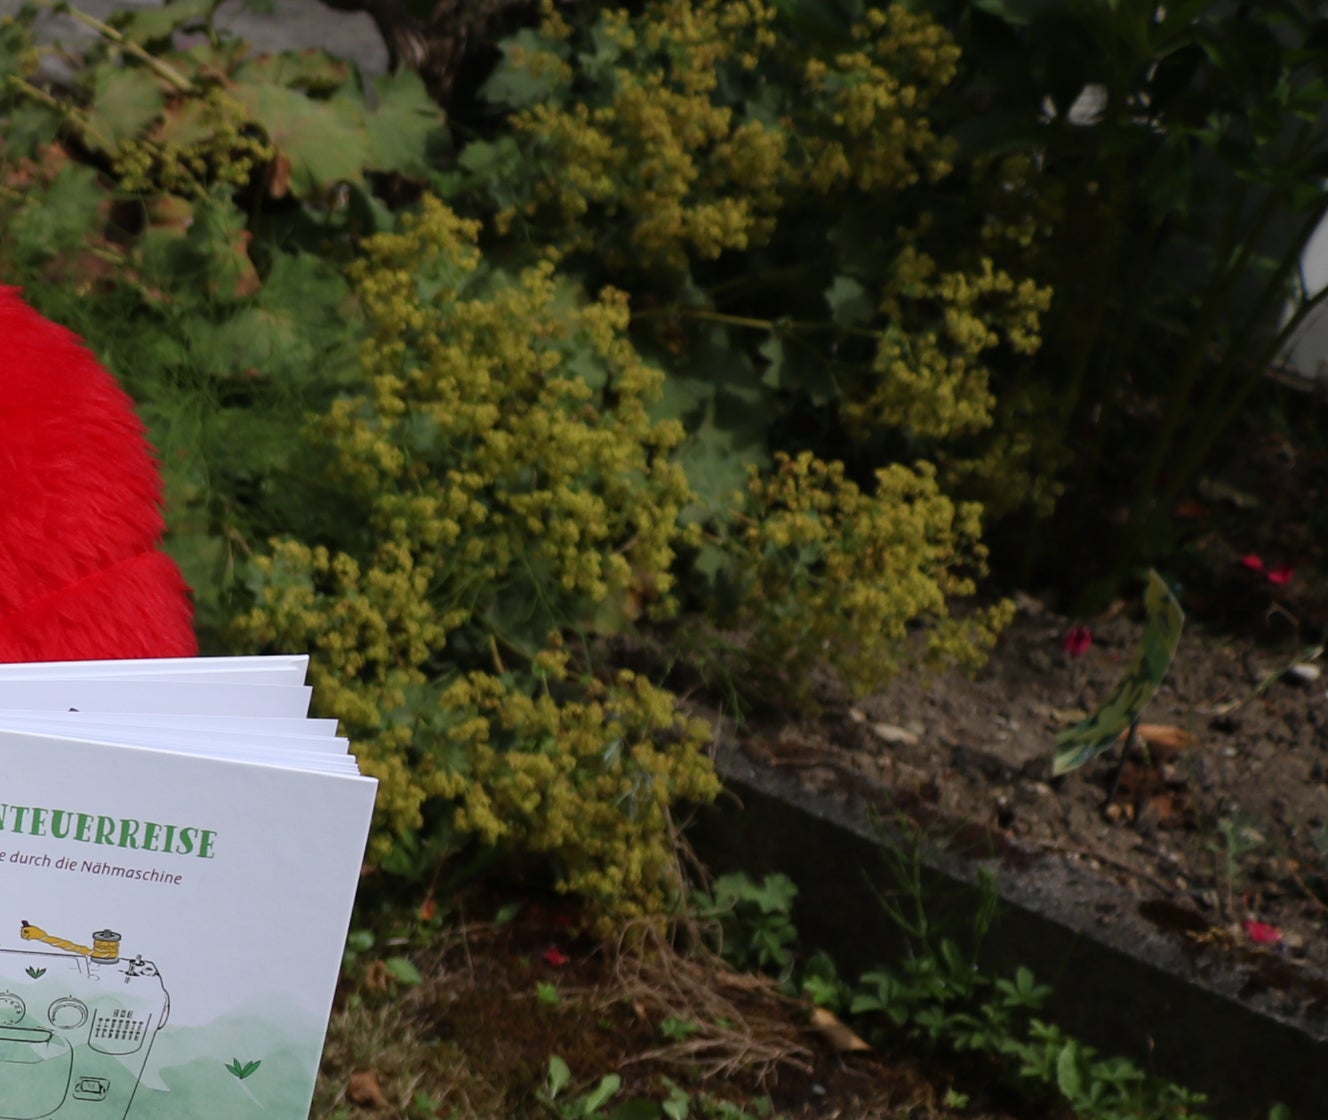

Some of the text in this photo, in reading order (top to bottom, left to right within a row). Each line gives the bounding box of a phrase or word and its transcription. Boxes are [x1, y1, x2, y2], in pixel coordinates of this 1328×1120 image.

[9, 850, 51, 867] durch
[55, 856, 78, 871] die
[81, 860, 183, 885] Nähmaschine
